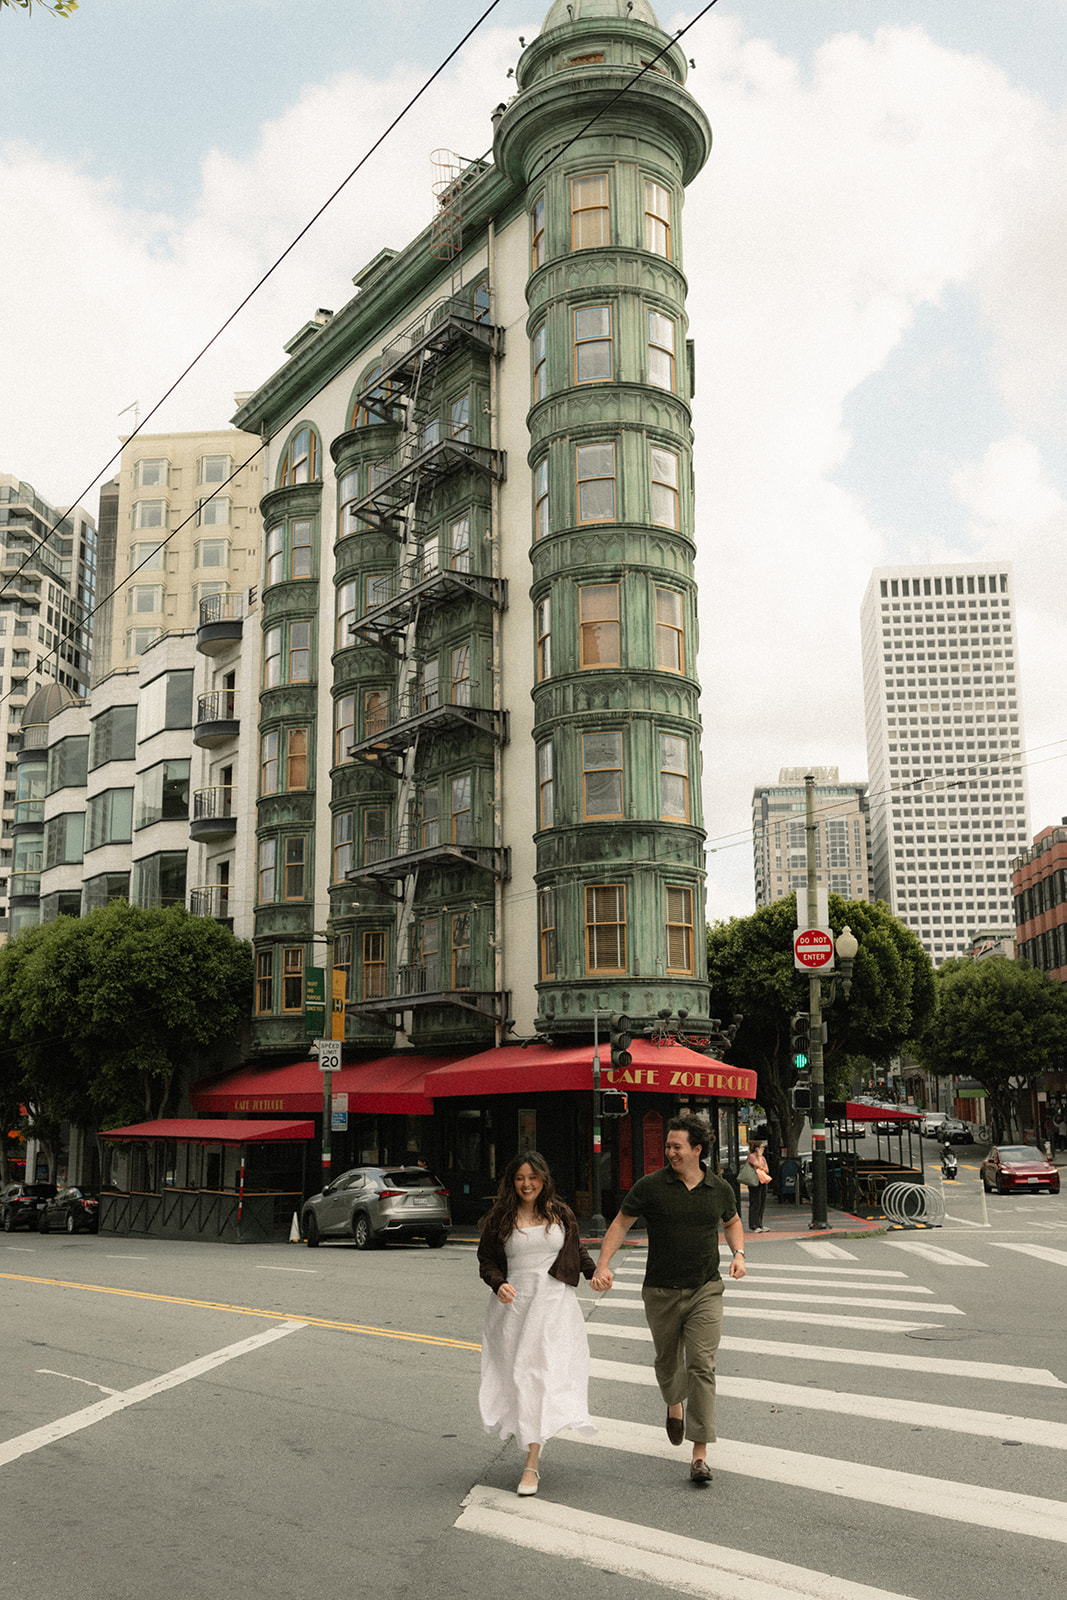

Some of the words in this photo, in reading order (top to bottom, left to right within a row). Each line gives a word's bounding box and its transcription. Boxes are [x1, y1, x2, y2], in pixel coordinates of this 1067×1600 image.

[813, 936, 827, 944] NOT
[688, 1035, 711, 1047] Bar
[322, 1056, 339, 1067] 20
[606, 1069, 660, 1085] CAFE
[669, 1070, 751, 1092] ZOETROPE
